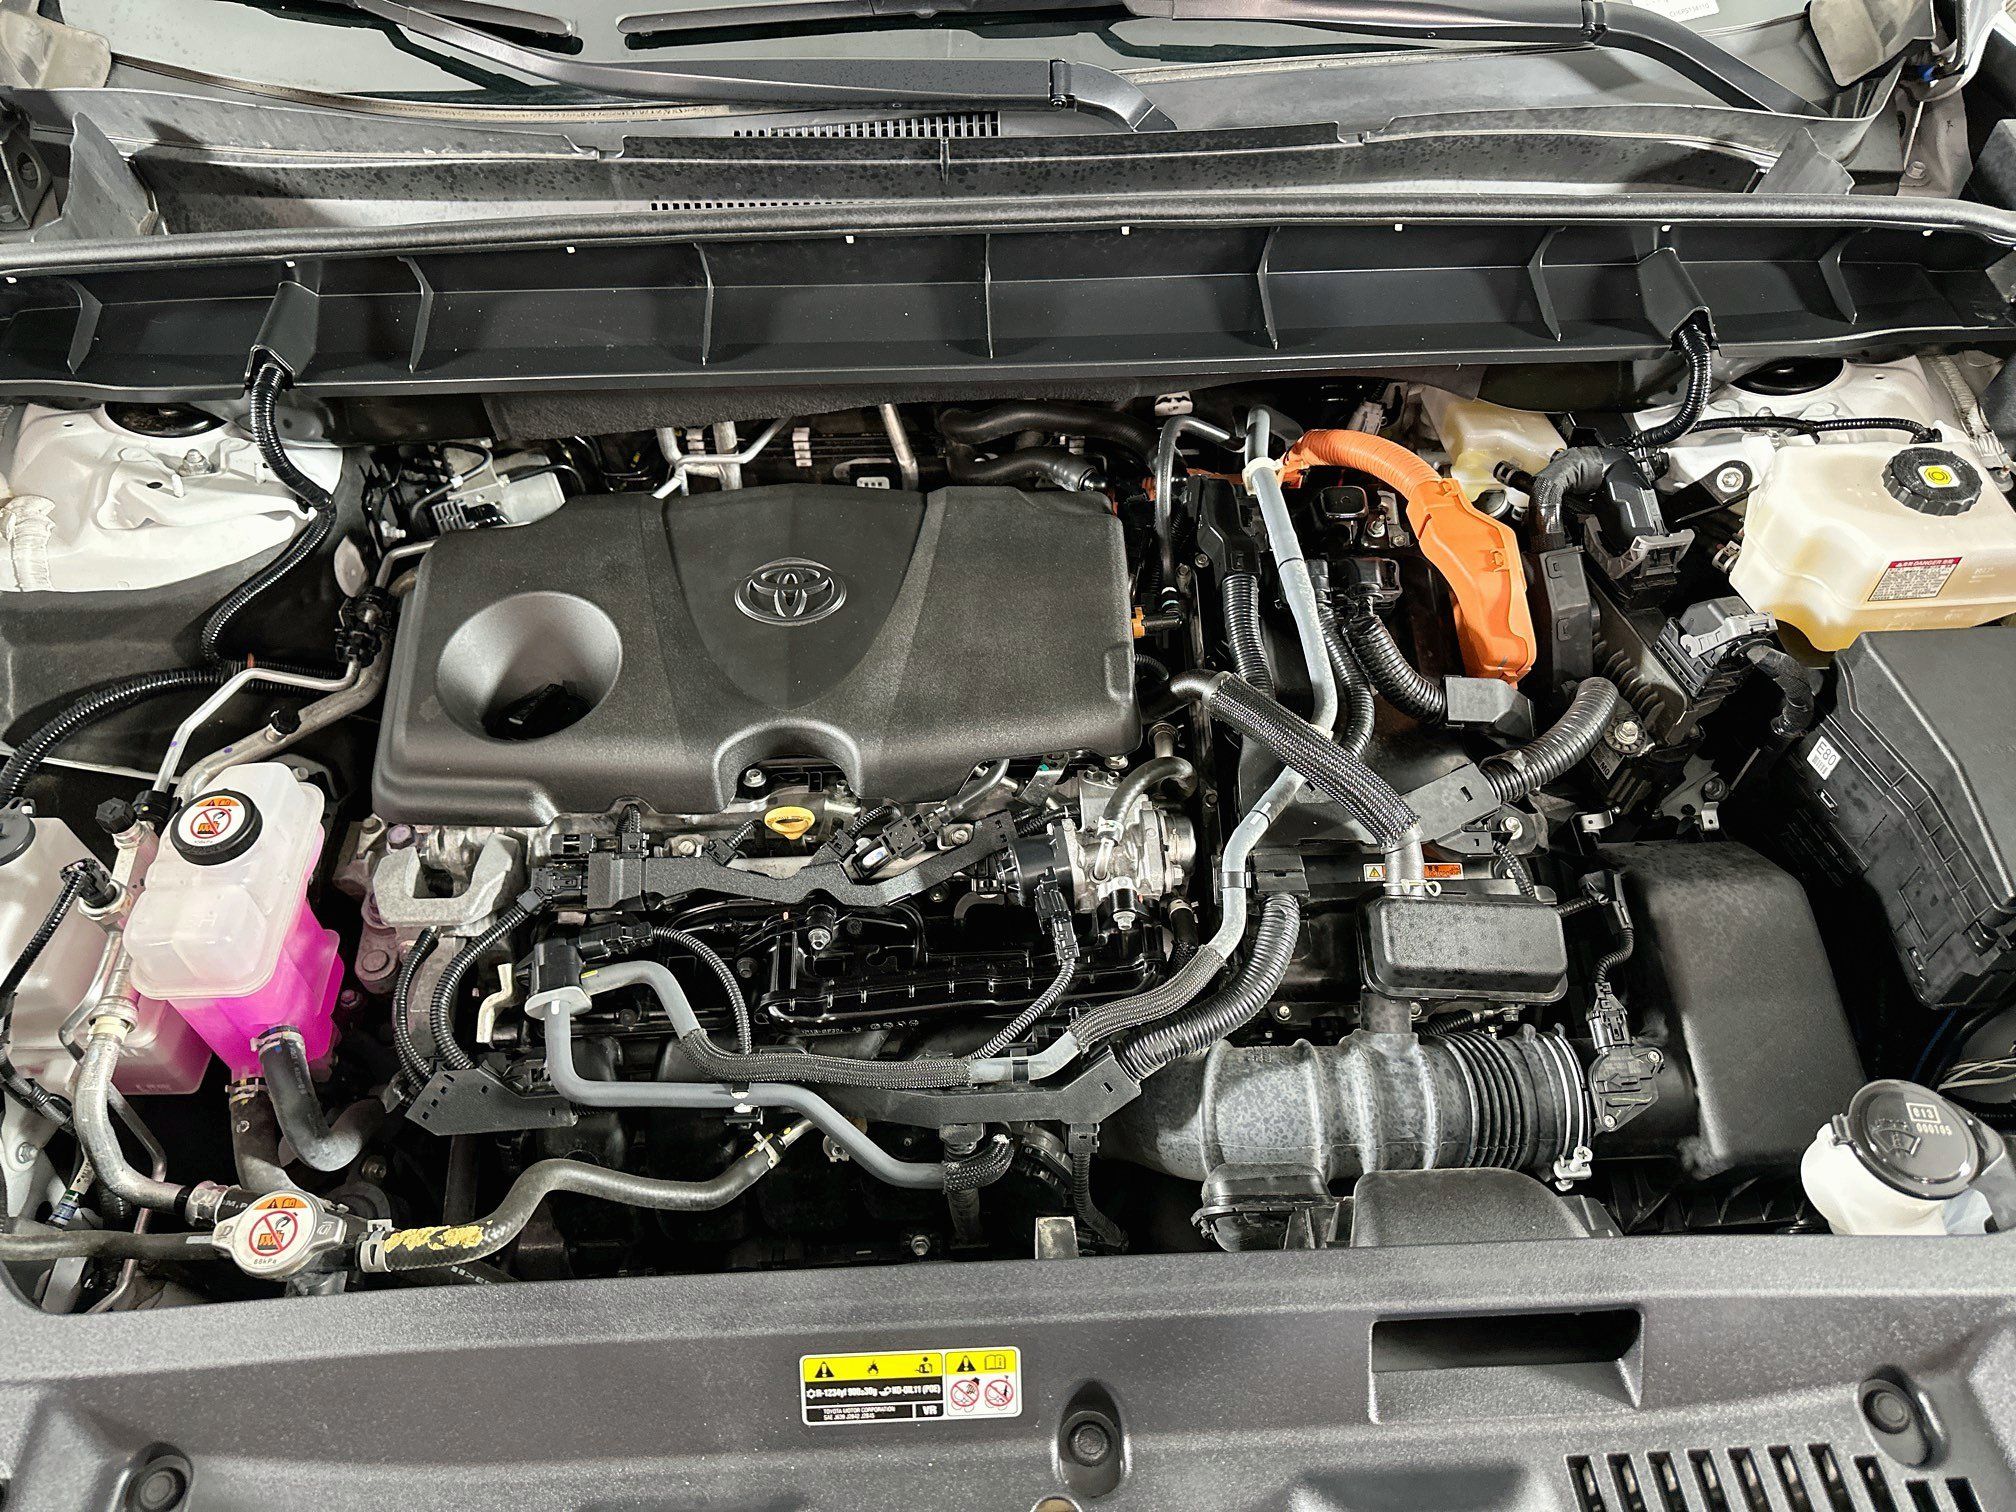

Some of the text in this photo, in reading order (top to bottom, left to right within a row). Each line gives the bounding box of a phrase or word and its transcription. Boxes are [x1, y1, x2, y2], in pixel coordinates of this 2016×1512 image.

[1913, 559, 1942, 567] DANGER
[1816, 741, 1837, 766] E80
[1912, 1107, 1935, 1119] e13
[860, 1405, 896, 1413] CORPORATION
[922, 1405, 938, 1416] VR
